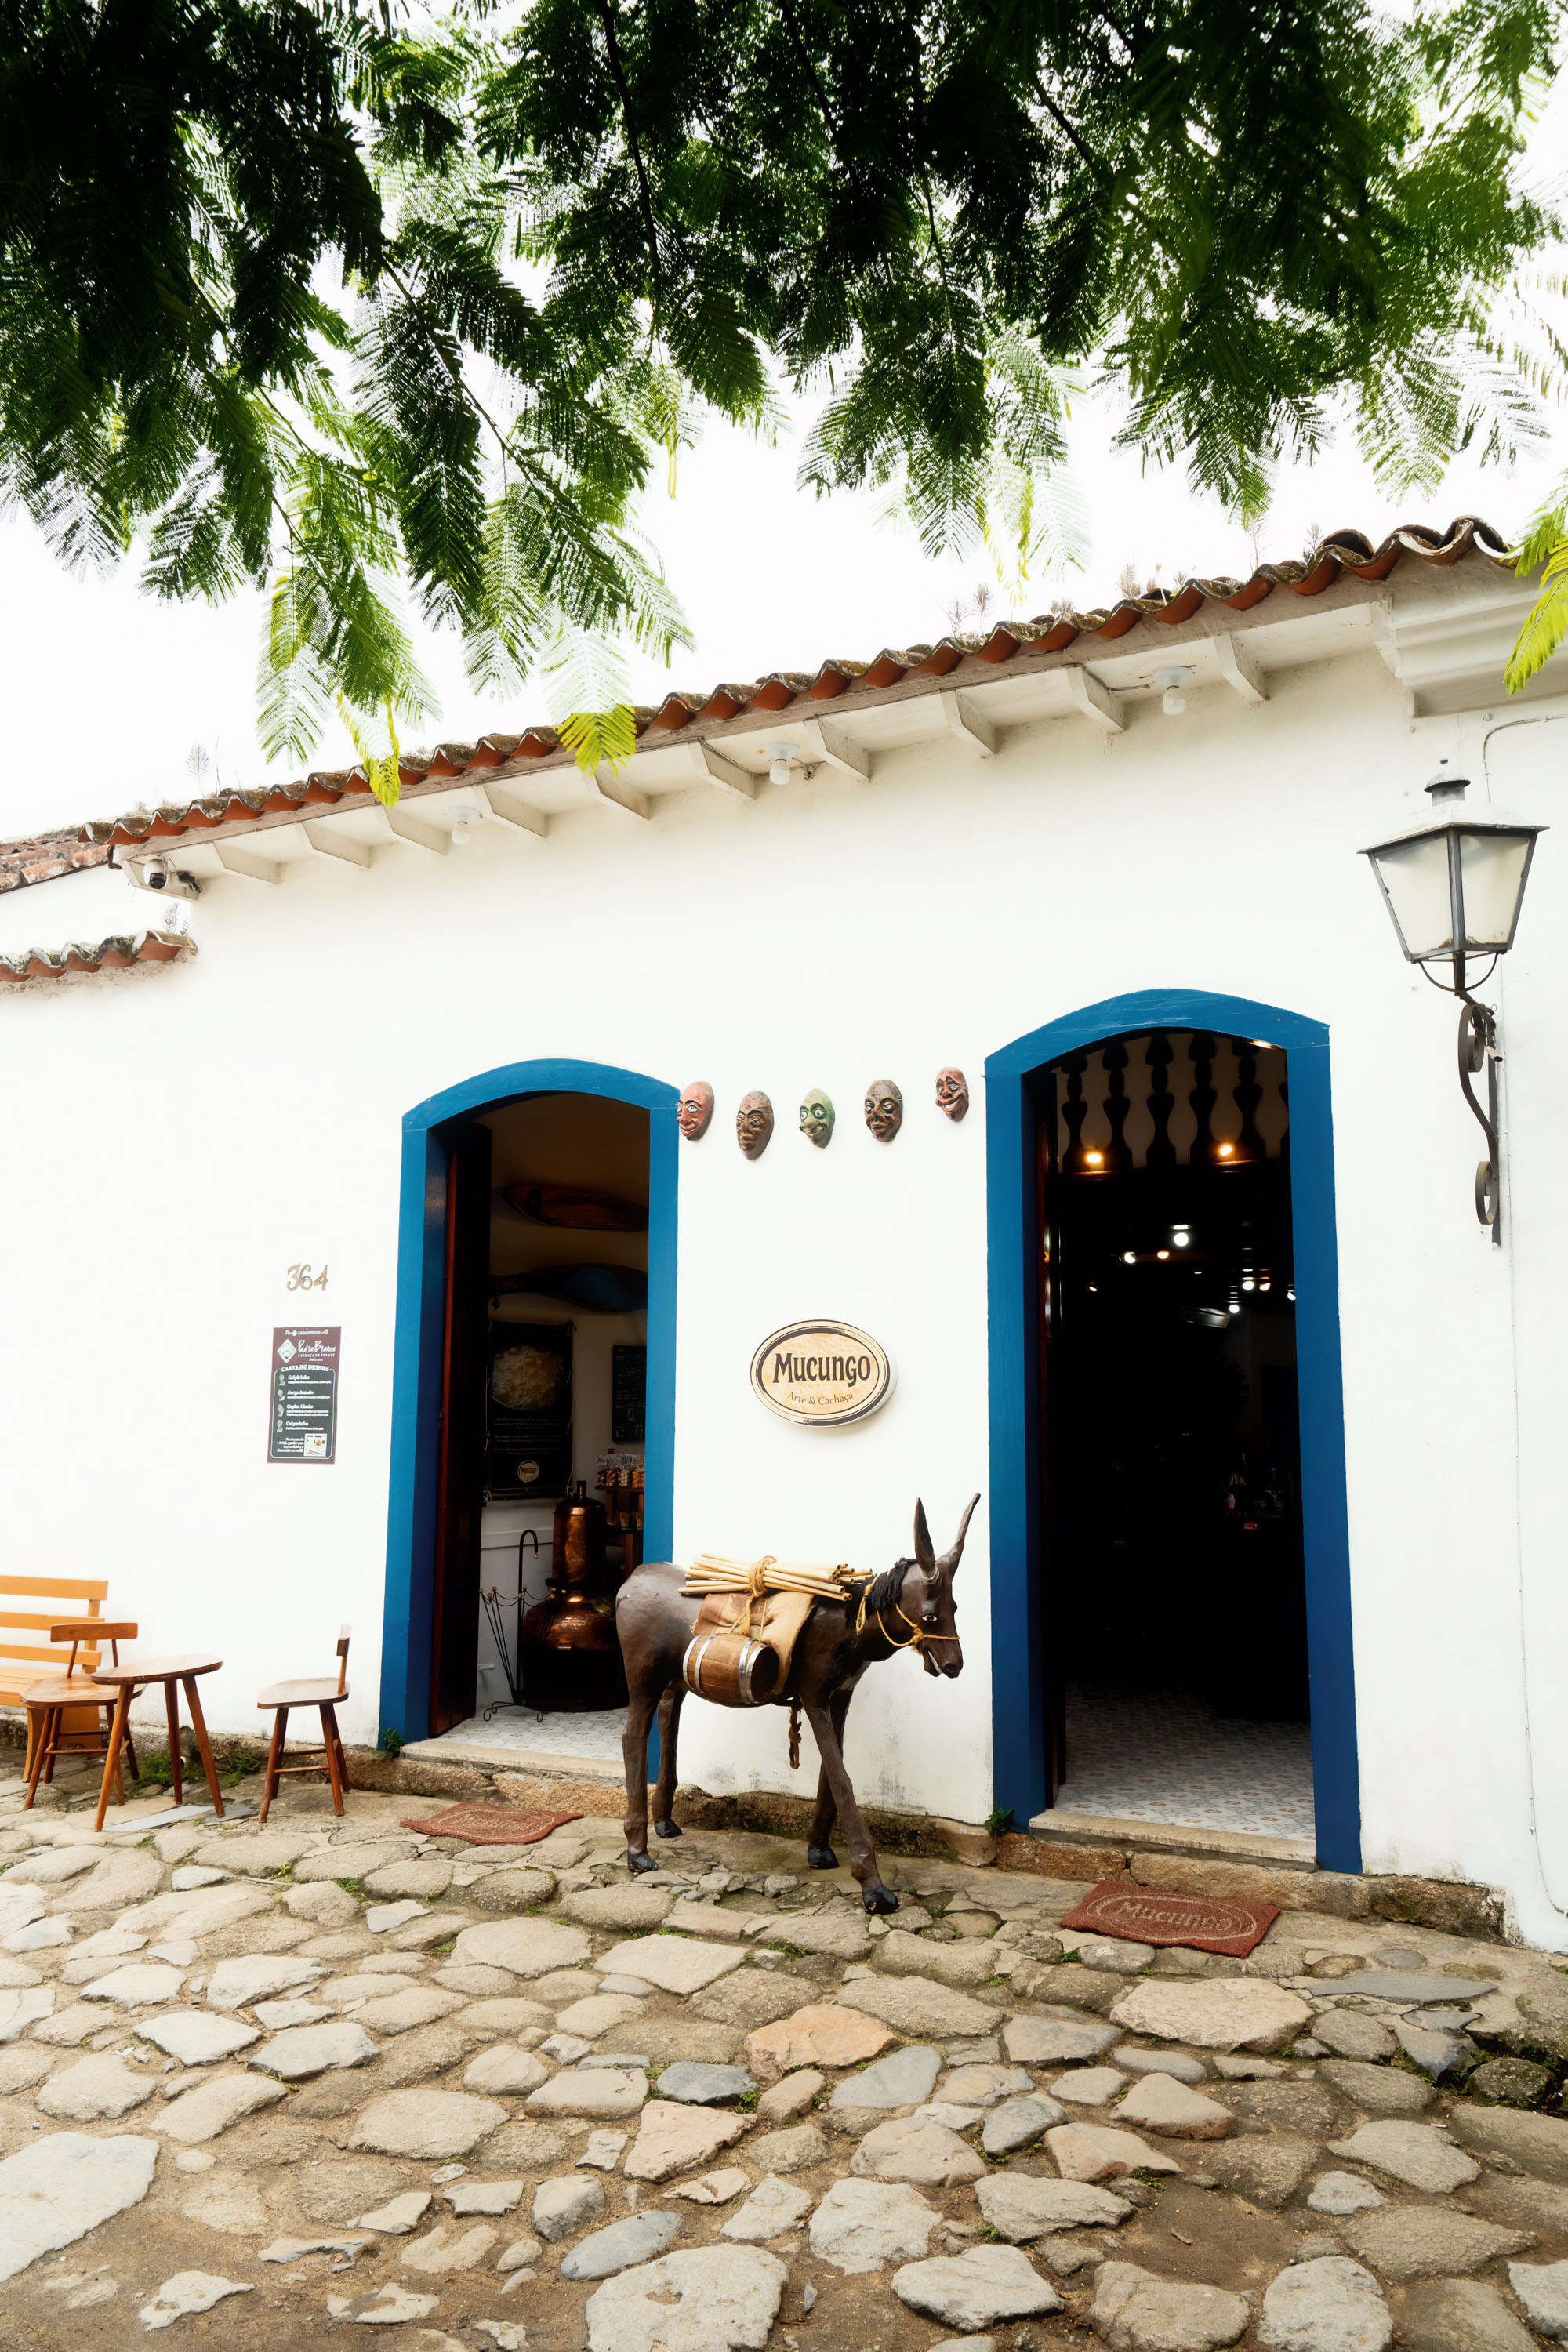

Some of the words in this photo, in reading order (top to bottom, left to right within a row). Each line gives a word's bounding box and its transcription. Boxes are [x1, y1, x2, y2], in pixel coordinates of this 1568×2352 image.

[286, 1263, 329, 1292] 364
[772, 1352, 871, 1388] Mucungo
[787, 1392, 807, 1404] Arte
[808, 1396, 815, 1405] &
[818, 1392, 854, 1406] Cachaça
